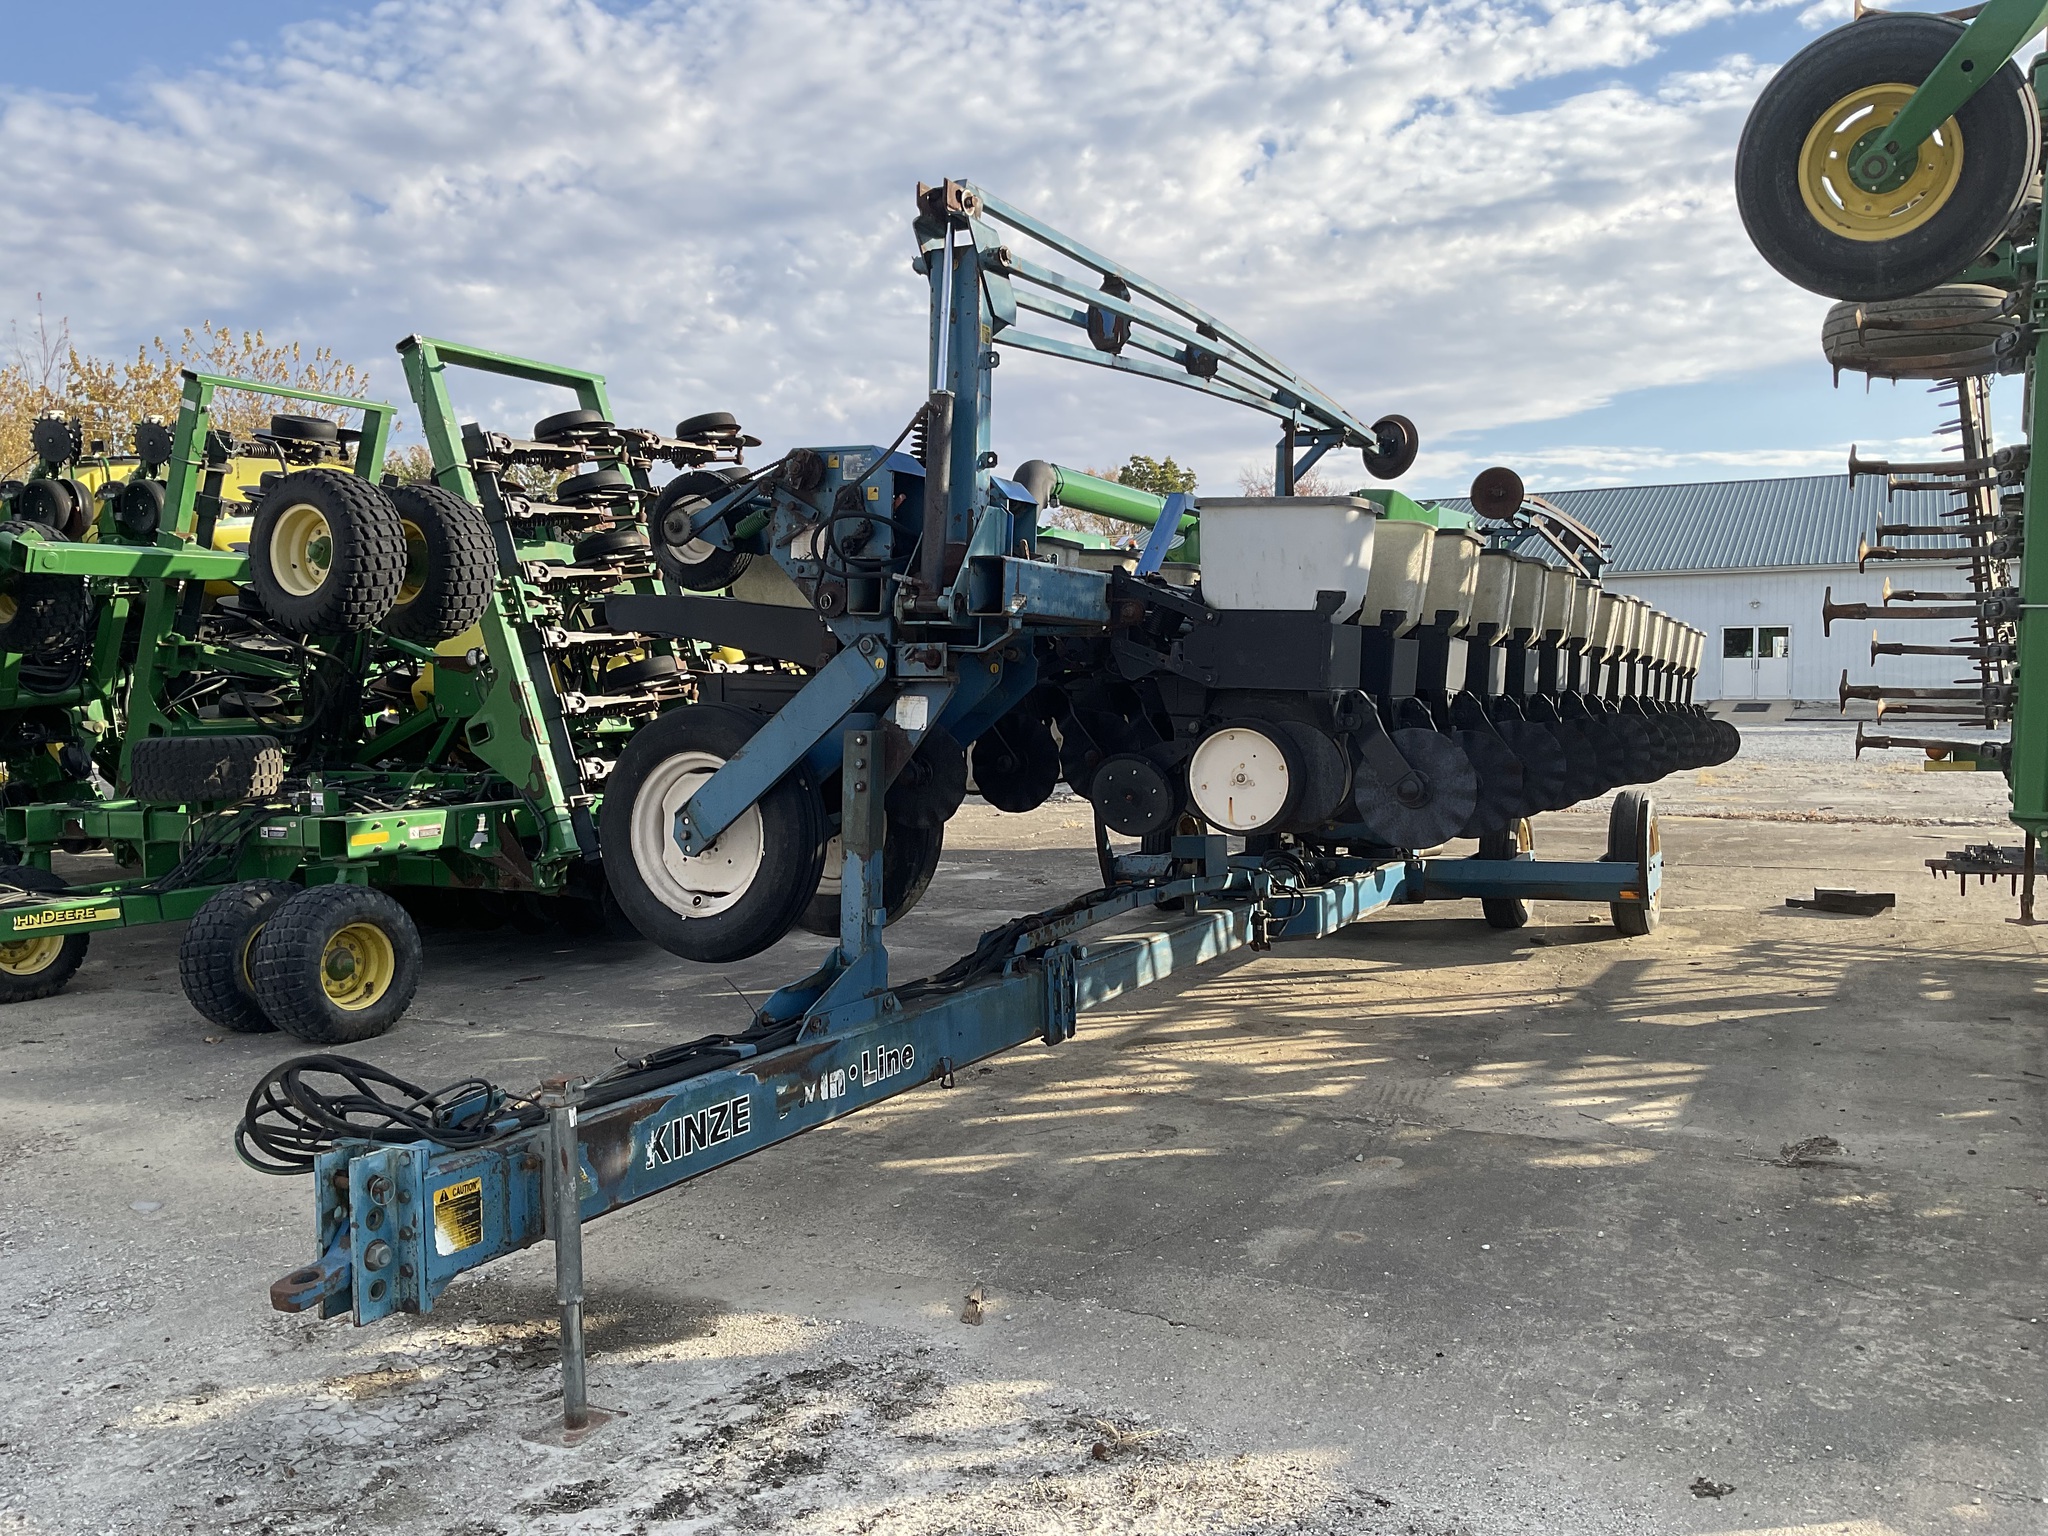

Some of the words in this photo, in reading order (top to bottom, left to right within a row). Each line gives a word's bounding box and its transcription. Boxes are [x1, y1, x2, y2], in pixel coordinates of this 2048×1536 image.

[42, 907, 96, 924] DEERE
[645, 1093, 751, 1171] KINZE
[452, 1182, 477, 1197] CAUTION
